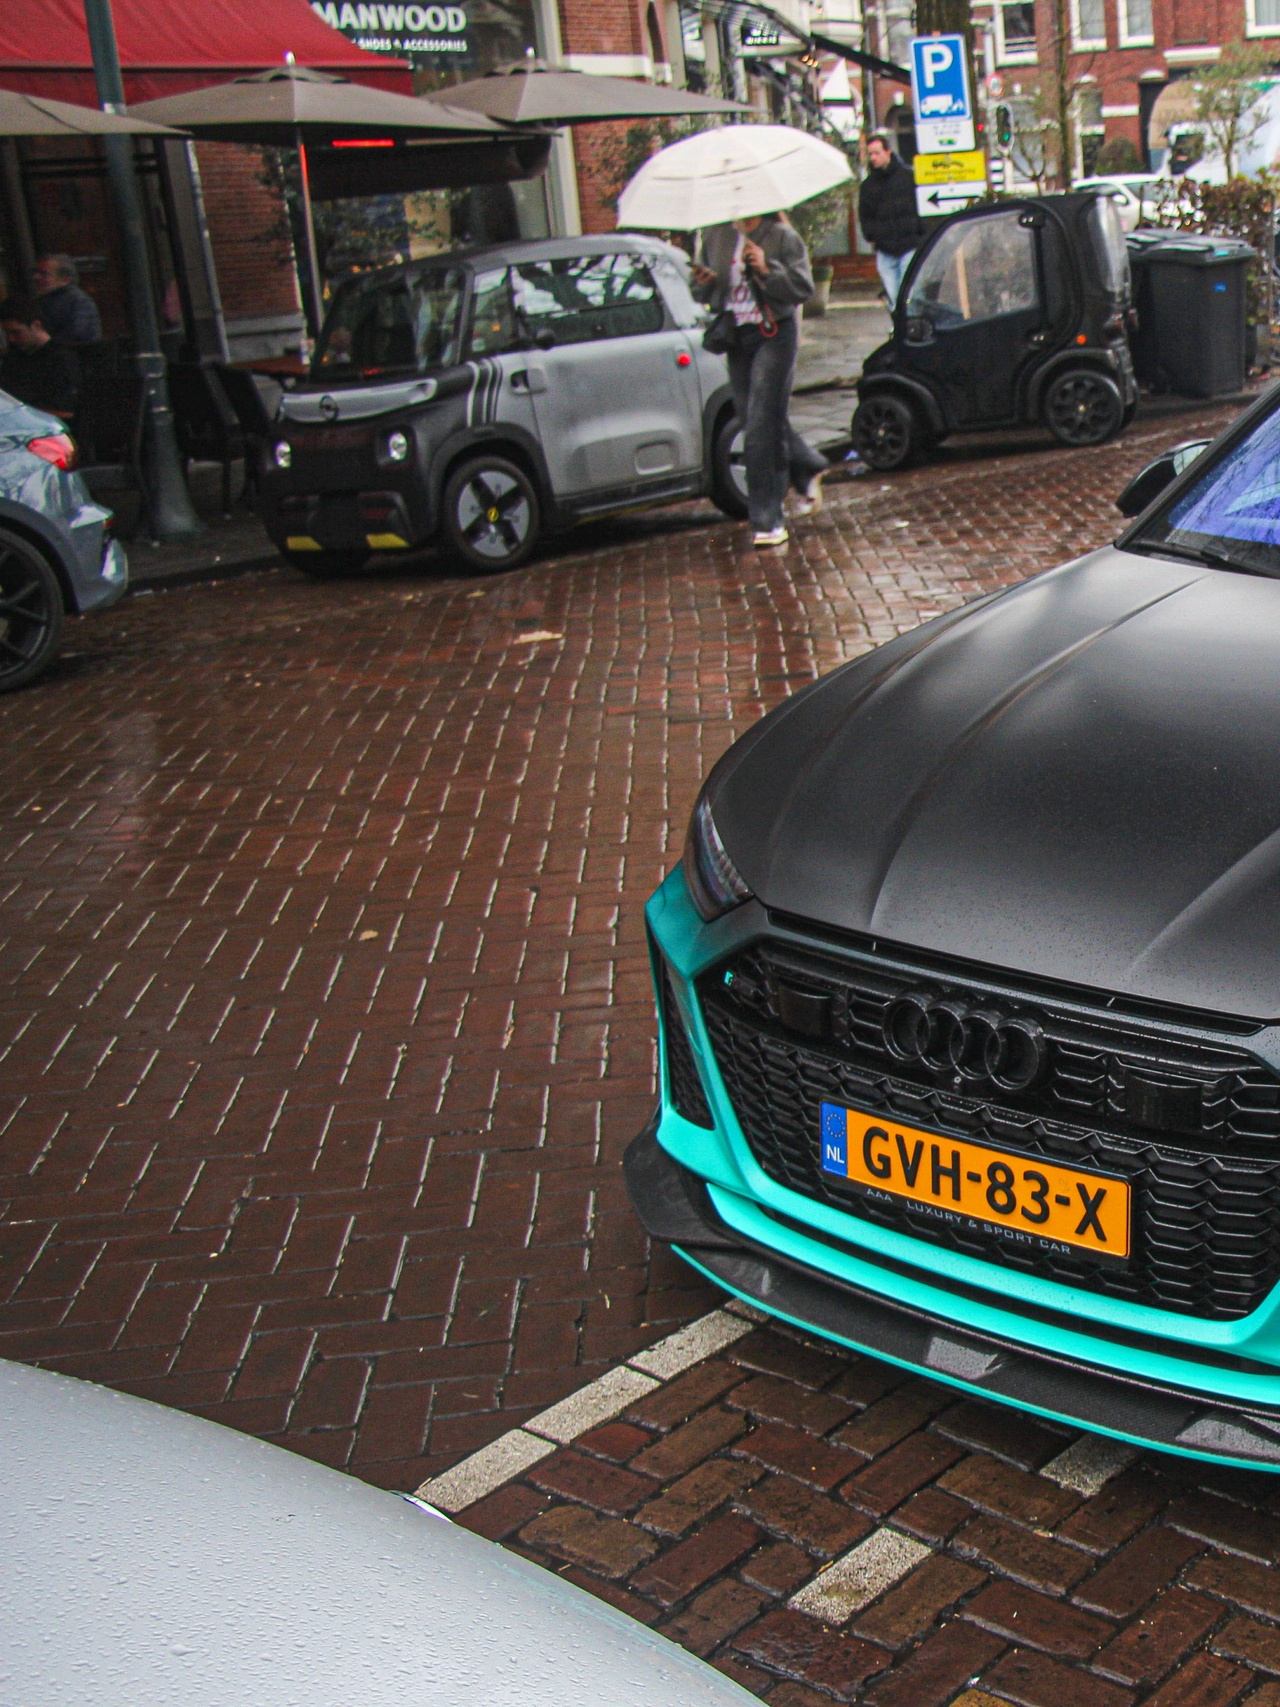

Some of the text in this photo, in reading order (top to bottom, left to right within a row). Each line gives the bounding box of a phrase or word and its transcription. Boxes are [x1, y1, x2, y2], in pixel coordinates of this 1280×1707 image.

[311, 2, 467, 32] MANWOOD
[358, 38, 392, 50] SHOES
[403, 39, 467, 52] ACCESSORIES
[922, 44, 953, 88] P
[826, 1143, 845, 1164] NL
[862, 1126, 1107, 1242] GVH-83-X
[866, 1187, 1071, 1255] AAA LUXURY & SPORT CAR
